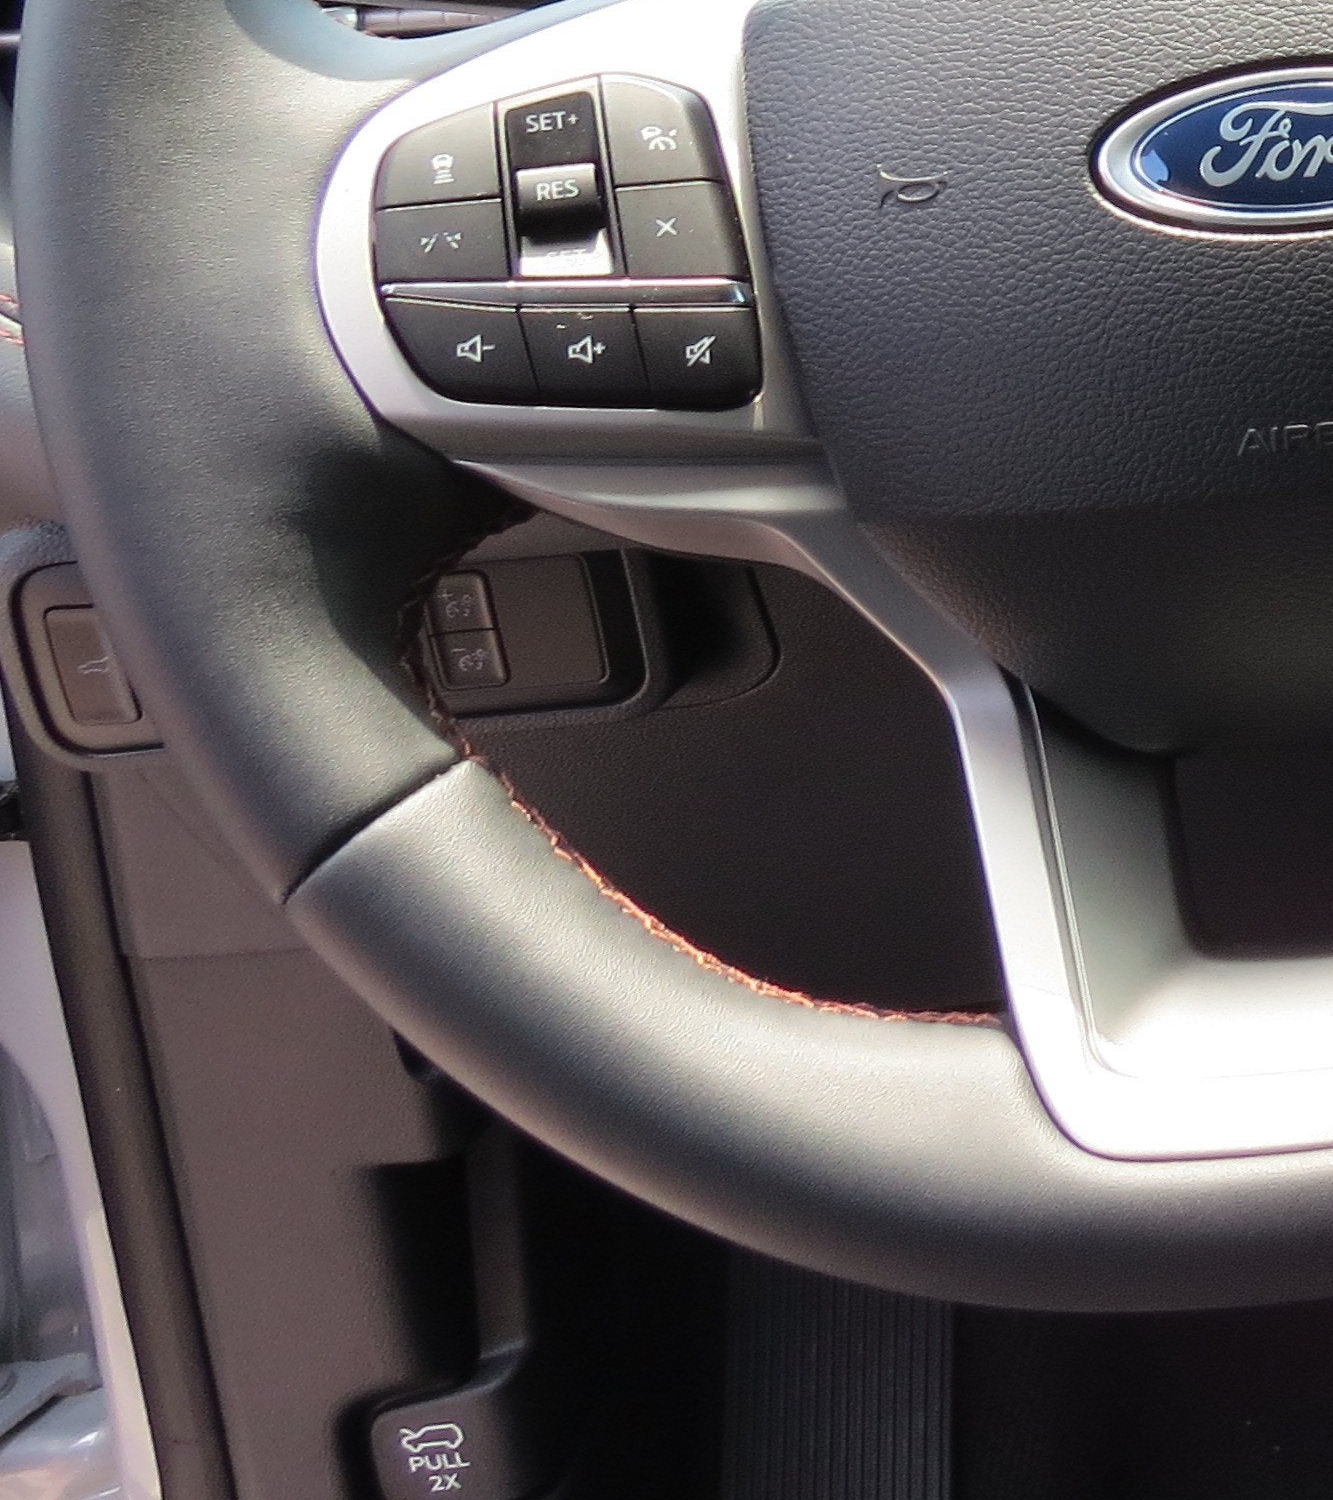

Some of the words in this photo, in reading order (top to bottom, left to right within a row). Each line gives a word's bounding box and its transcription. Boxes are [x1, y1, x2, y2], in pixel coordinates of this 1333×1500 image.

[535, 179, 580, 202] RES
[408, 1451, 471, 1473] PULL
[428, 1472, 462, 1493] 2X
